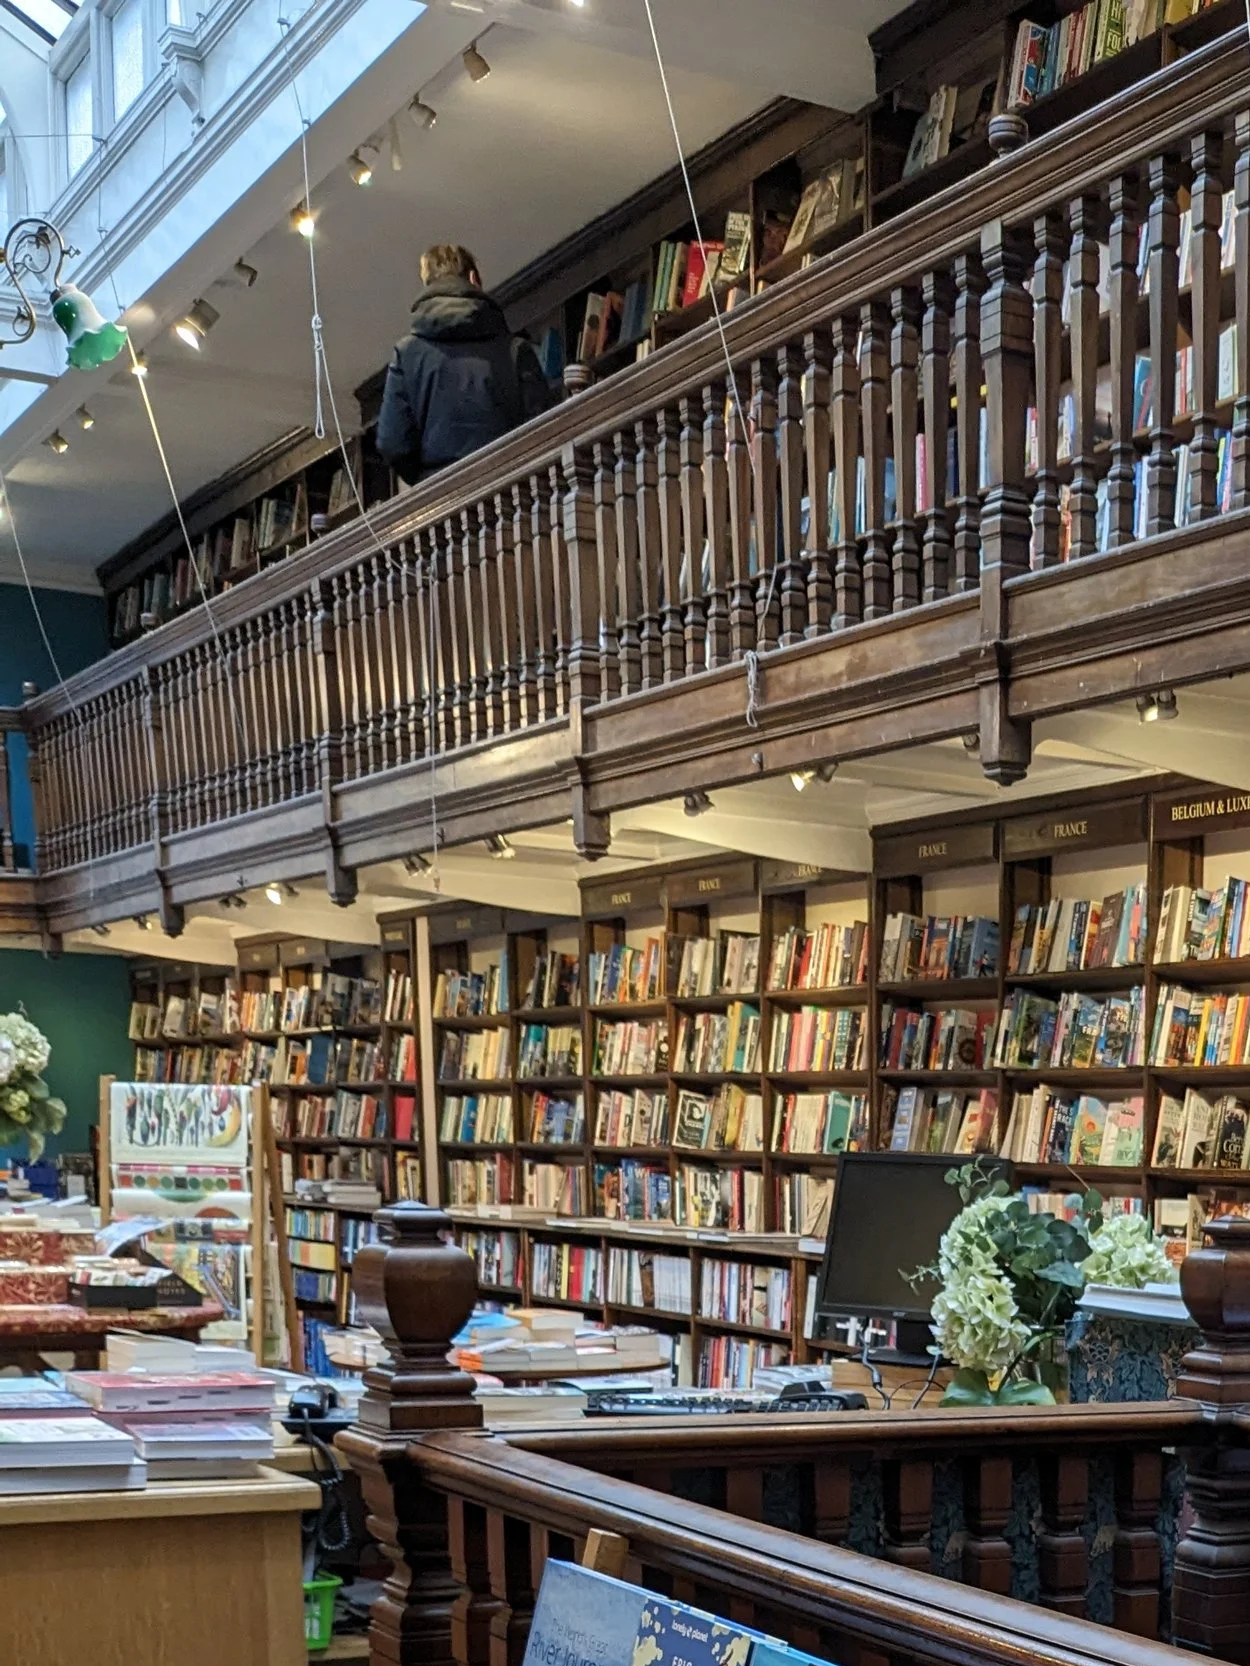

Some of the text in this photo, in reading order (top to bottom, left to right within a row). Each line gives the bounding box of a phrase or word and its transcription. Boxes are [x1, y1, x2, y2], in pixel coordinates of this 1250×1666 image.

[1171, 800, 1225, 820] BELGIUM &
[1054, 821, 1088, 839] FRANCE
[918, 842, 948, 858] FRANCE
[699, 878, 720, 892] FRANCE
[611, 892, 631, 905] FRANCE
[530, 1631, 559, 1665] River
